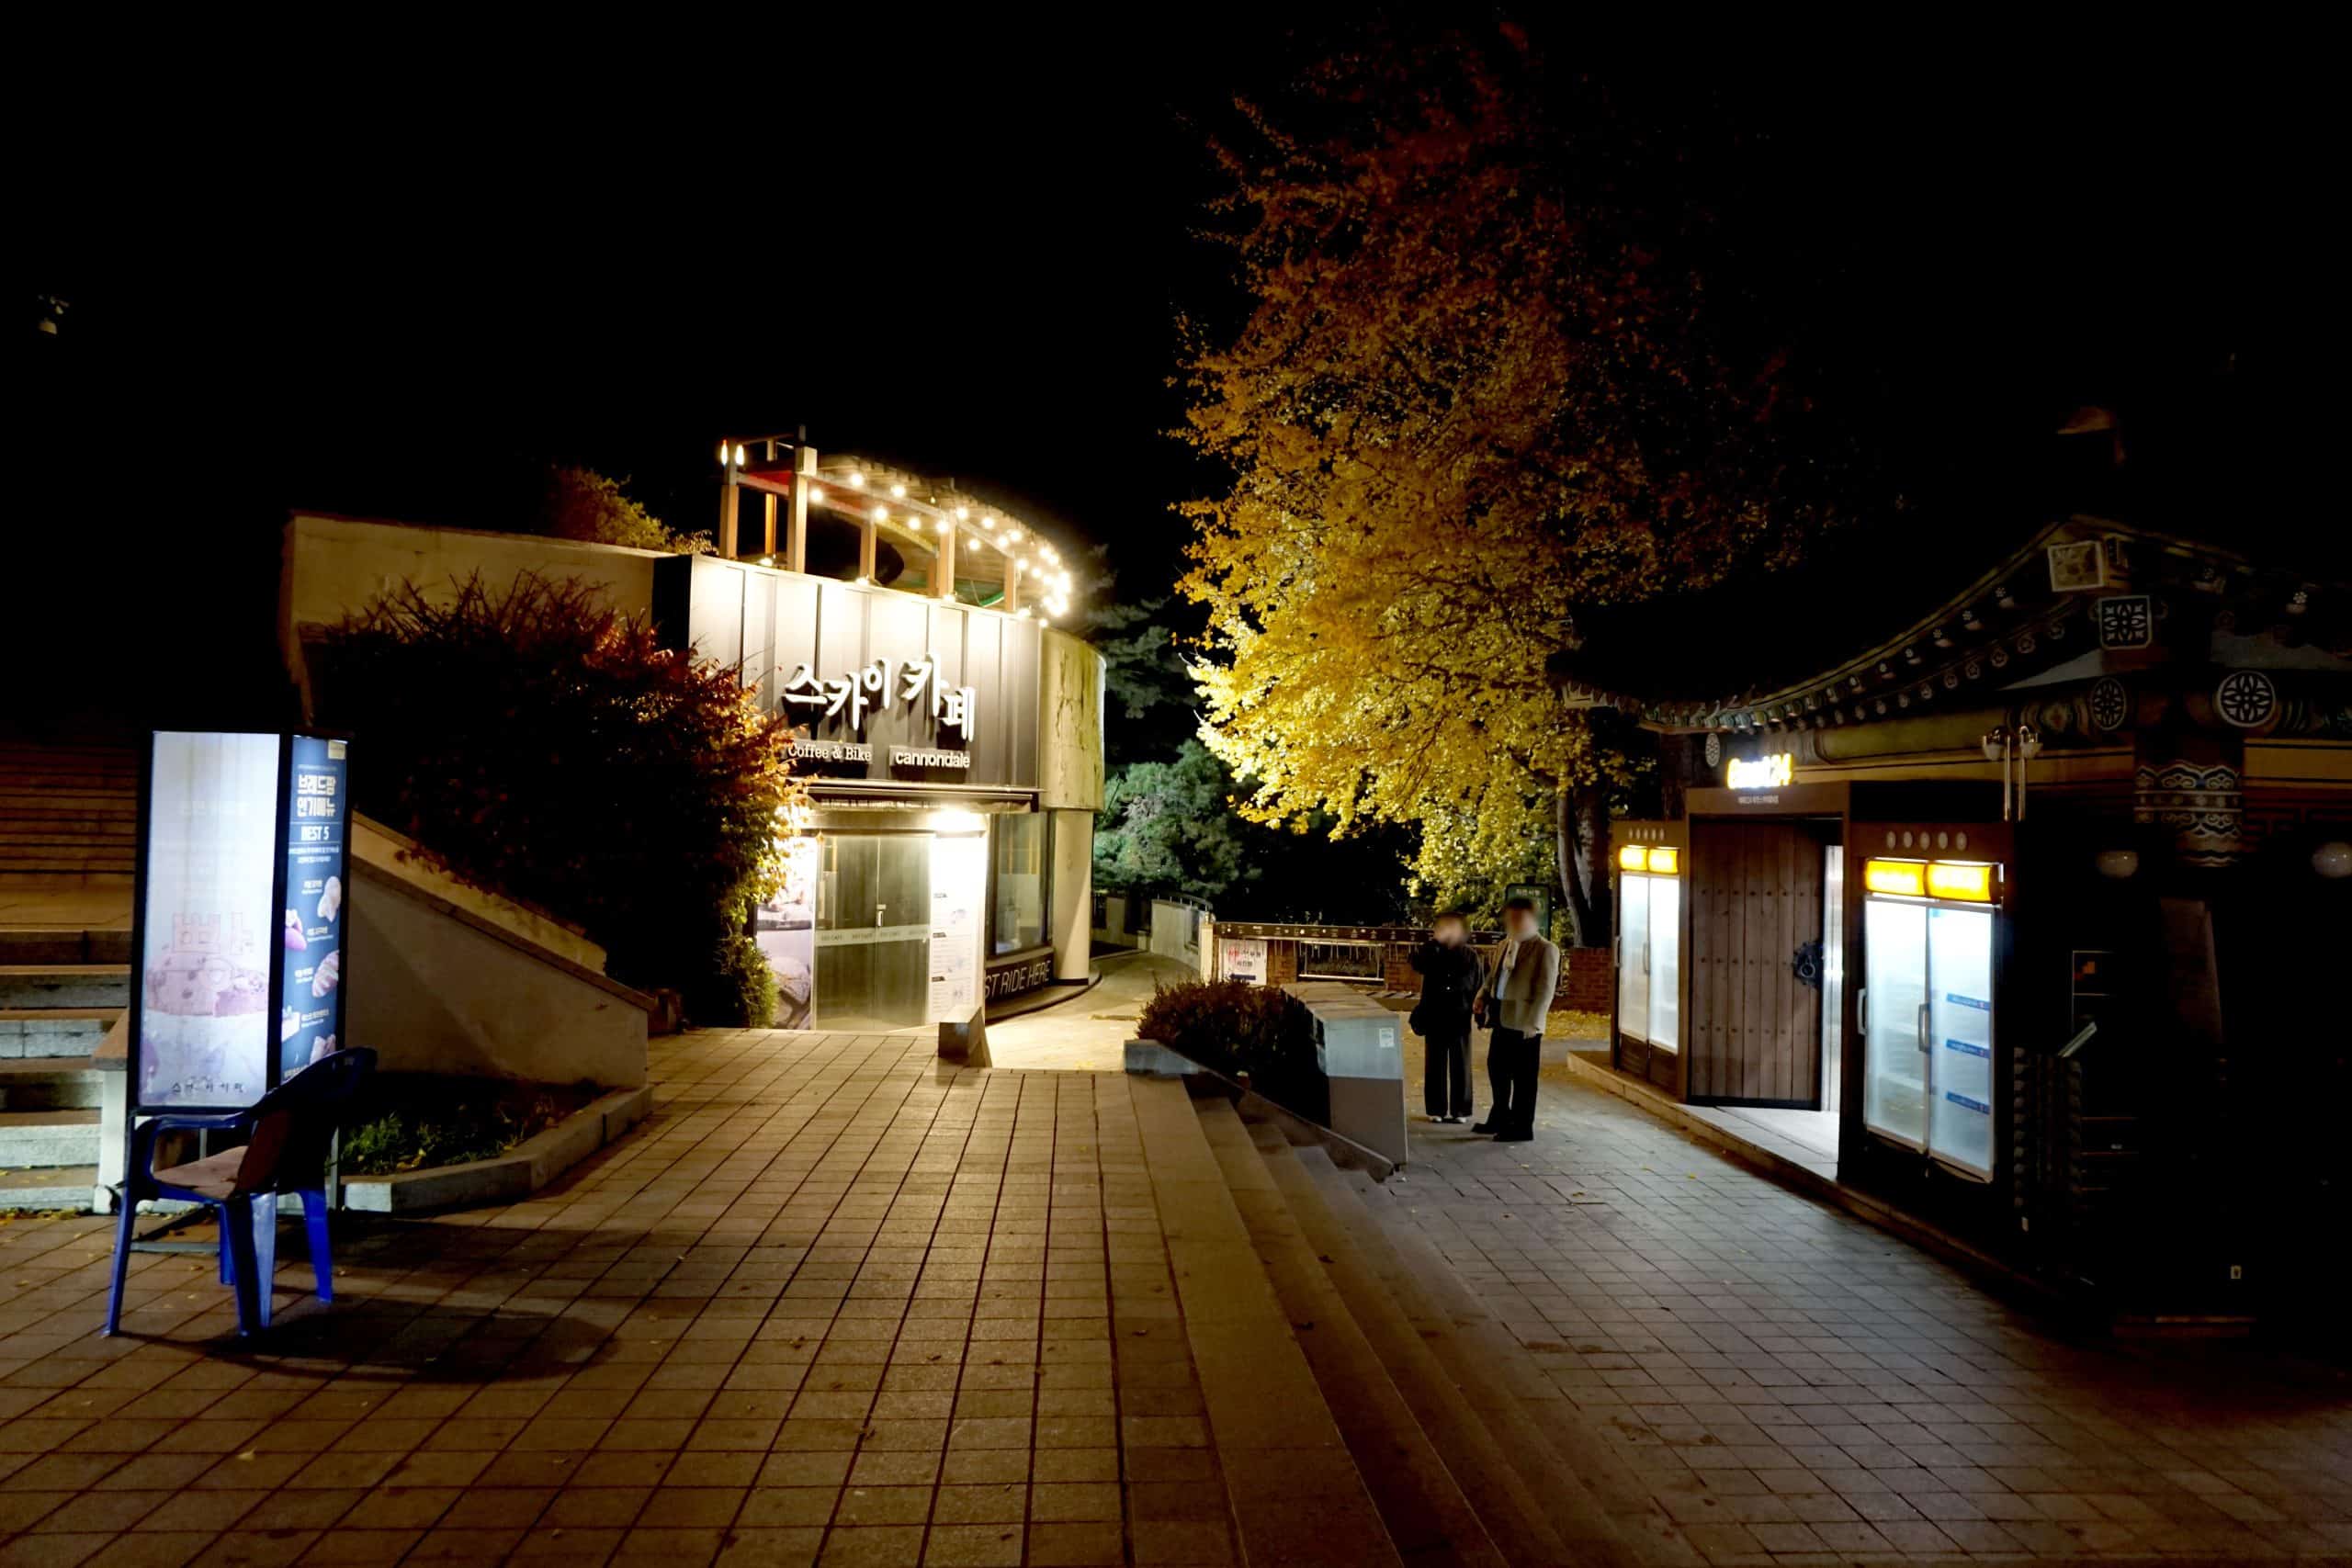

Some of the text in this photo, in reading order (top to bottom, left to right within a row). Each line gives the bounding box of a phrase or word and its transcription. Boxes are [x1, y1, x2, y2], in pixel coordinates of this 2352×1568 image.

[783, 653, 976, 742] 스카이 카페
[787, 743, 873, 762] Coffee & Bike
[895, 750, 971, 769] cannondale
[300, 826, 330, 841] BEST 5
[1000, 966, 1027, 994] RIDE
[1027, 959, 1052, 987] HERE
